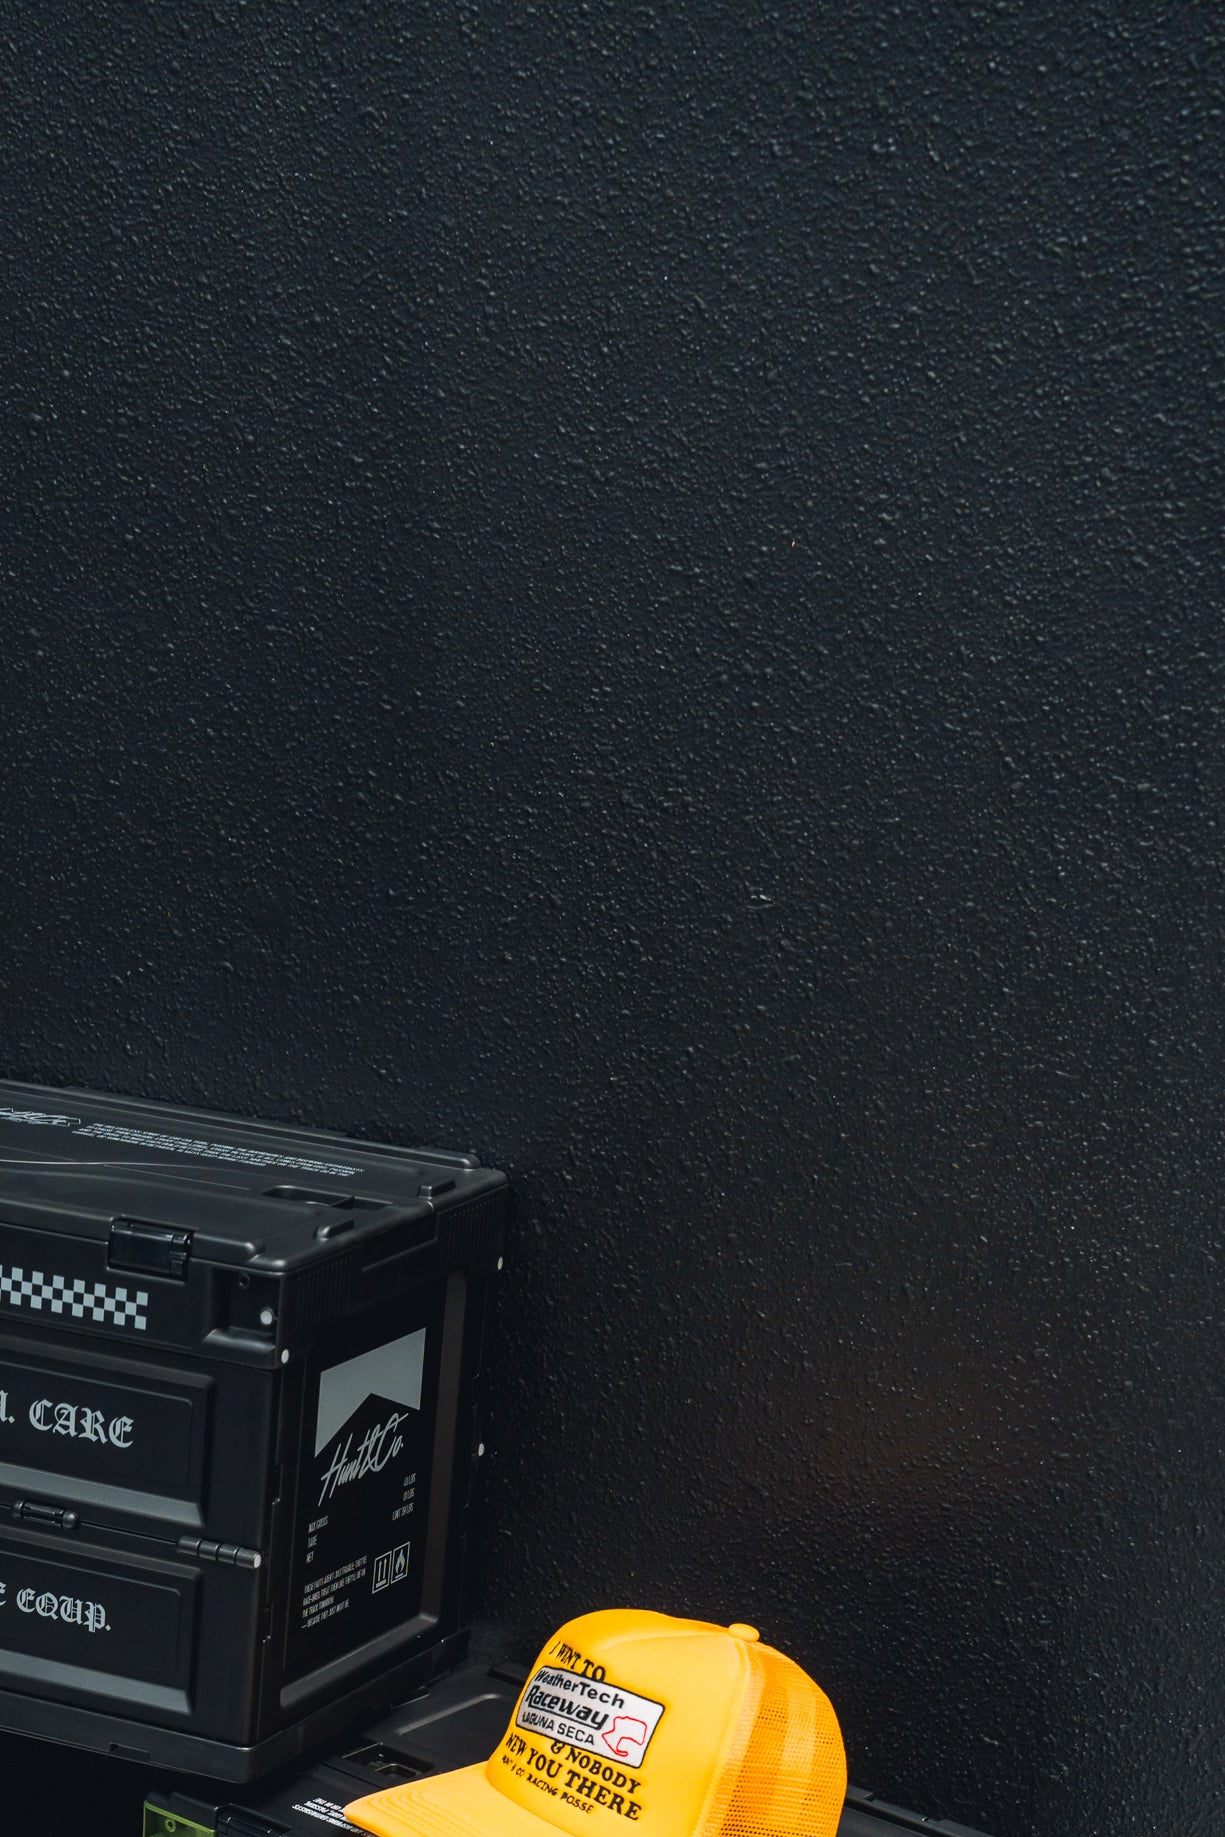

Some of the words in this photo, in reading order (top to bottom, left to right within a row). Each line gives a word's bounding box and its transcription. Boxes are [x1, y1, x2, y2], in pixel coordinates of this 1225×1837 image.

[29, 1399, 134, 1448] CARE
[16, 1588, 112, 1633] EQUP.
[534, 1670, 625, 1709] WeatherTech
[580, 1659, 606, 1682] TO
[522, 1711, 555, 1731] LAGUNA
[557, 1723, 595, 1745] SECA
[525, 1685, 609, 1730] Raceway
[527, 1748, 563, 1778] YOU
[564, 1769, 642, 1821] THERE
[565, 1746, 641, 1794] NOBODY
[527, 1773, 559, 1796] RACING
[560, 1792, 594, 1814] POSSE
